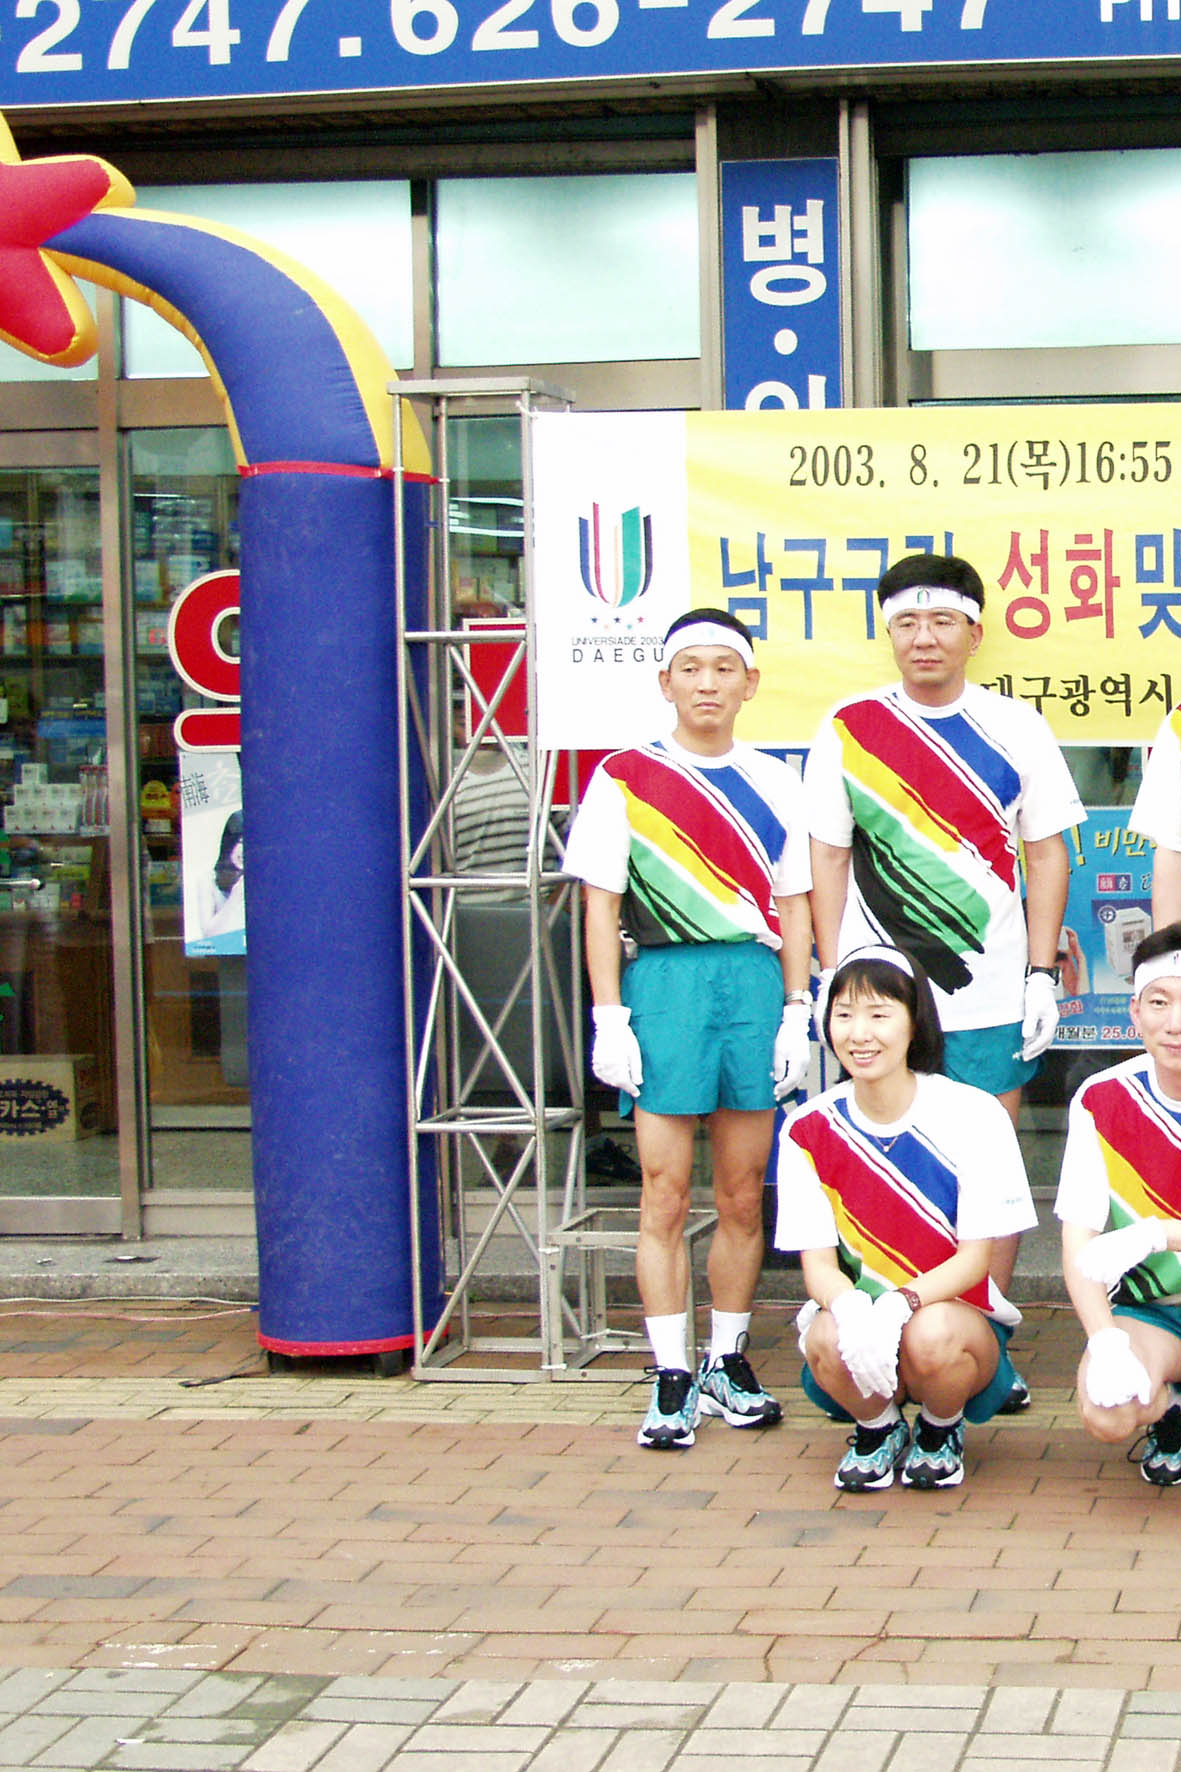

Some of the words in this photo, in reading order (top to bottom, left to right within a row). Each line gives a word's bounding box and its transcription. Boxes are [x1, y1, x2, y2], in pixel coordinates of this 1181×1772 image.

[789, 444, 884, 488] 2003.
[909, 444, 938, 487] 8.
[571, 636, 637, 646] UNIVERSIADE
[640, 636, 664, 646] 2003
[572, 648, 664, 663] DAEGU
